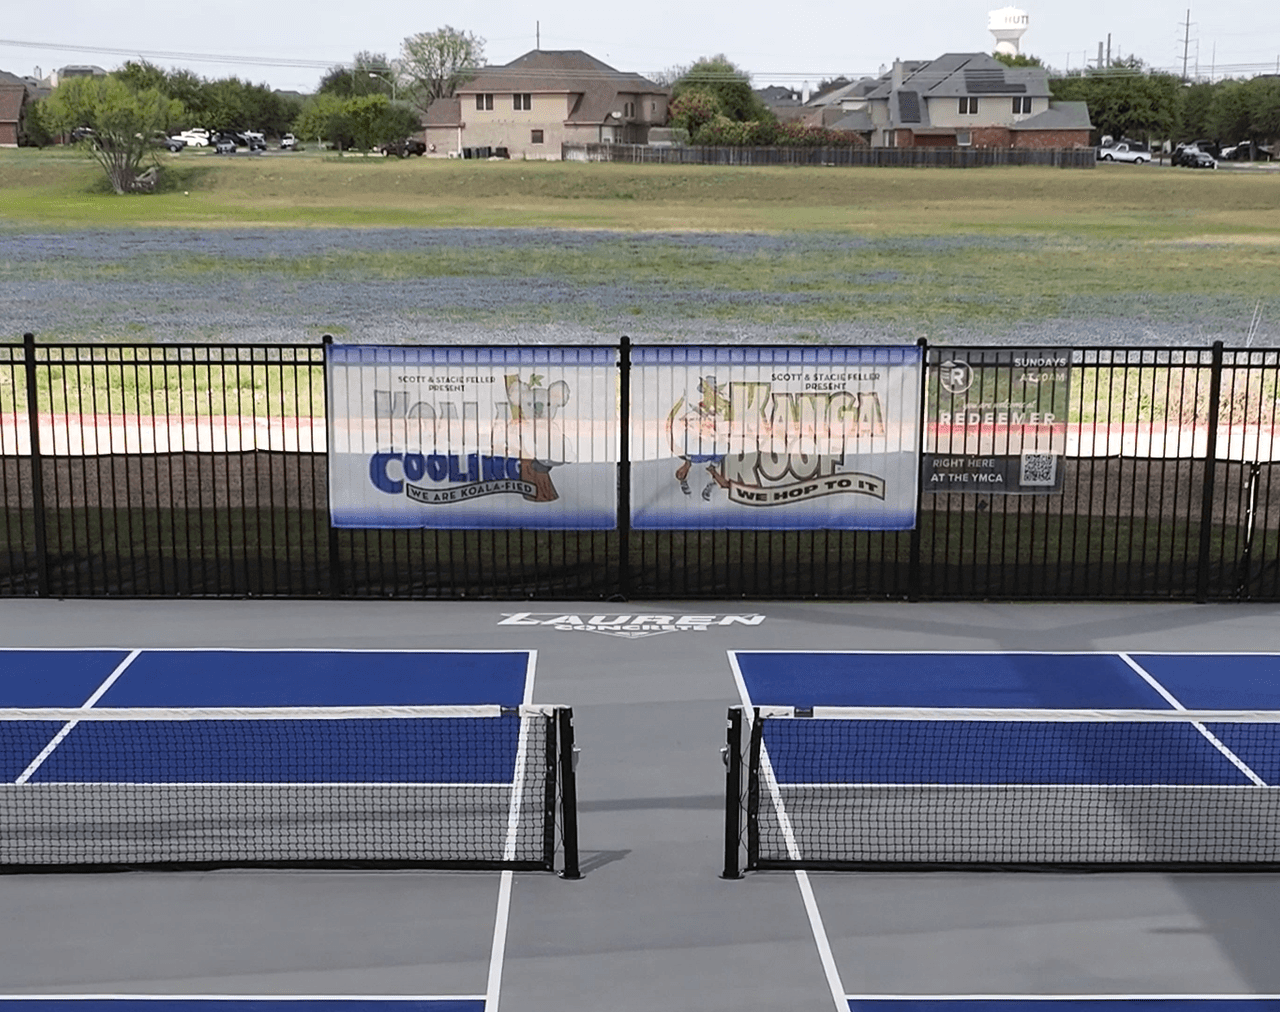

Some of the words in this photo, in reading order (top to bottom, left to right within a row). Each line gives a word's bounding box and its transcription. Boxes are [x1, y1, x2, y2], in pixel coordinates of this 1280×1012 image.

[1014, 358, 1066, 367] SUNDAYS
[771, 373, 802, 381] SCOTT
[805, 373, 810, 381] &
[813, 373, 846, 381] STACIE
[847, 373, 880, 381] FELLER
[729, 382, 887, 437] KANGA
[940, 412, 1056, 425] REDEEMER
[933, 459, 964, 468] RIGHT
[968, 459, 995, 468] HERE
[931, 473, 945, 482] AT
[948, 473, 969, 482] THE
[971, 473, 1003, 482] YMCA
[411, 489, 429, 500] WE
[434, 491, 456, 501] ARE
[736, 488, 767, 501] WE
[773, 484, 818, 500] HOP
[824, 479, 851, 490] TO
[858, 480, 878, 492] IT
[497, 612, 766, 626] LAUREN
